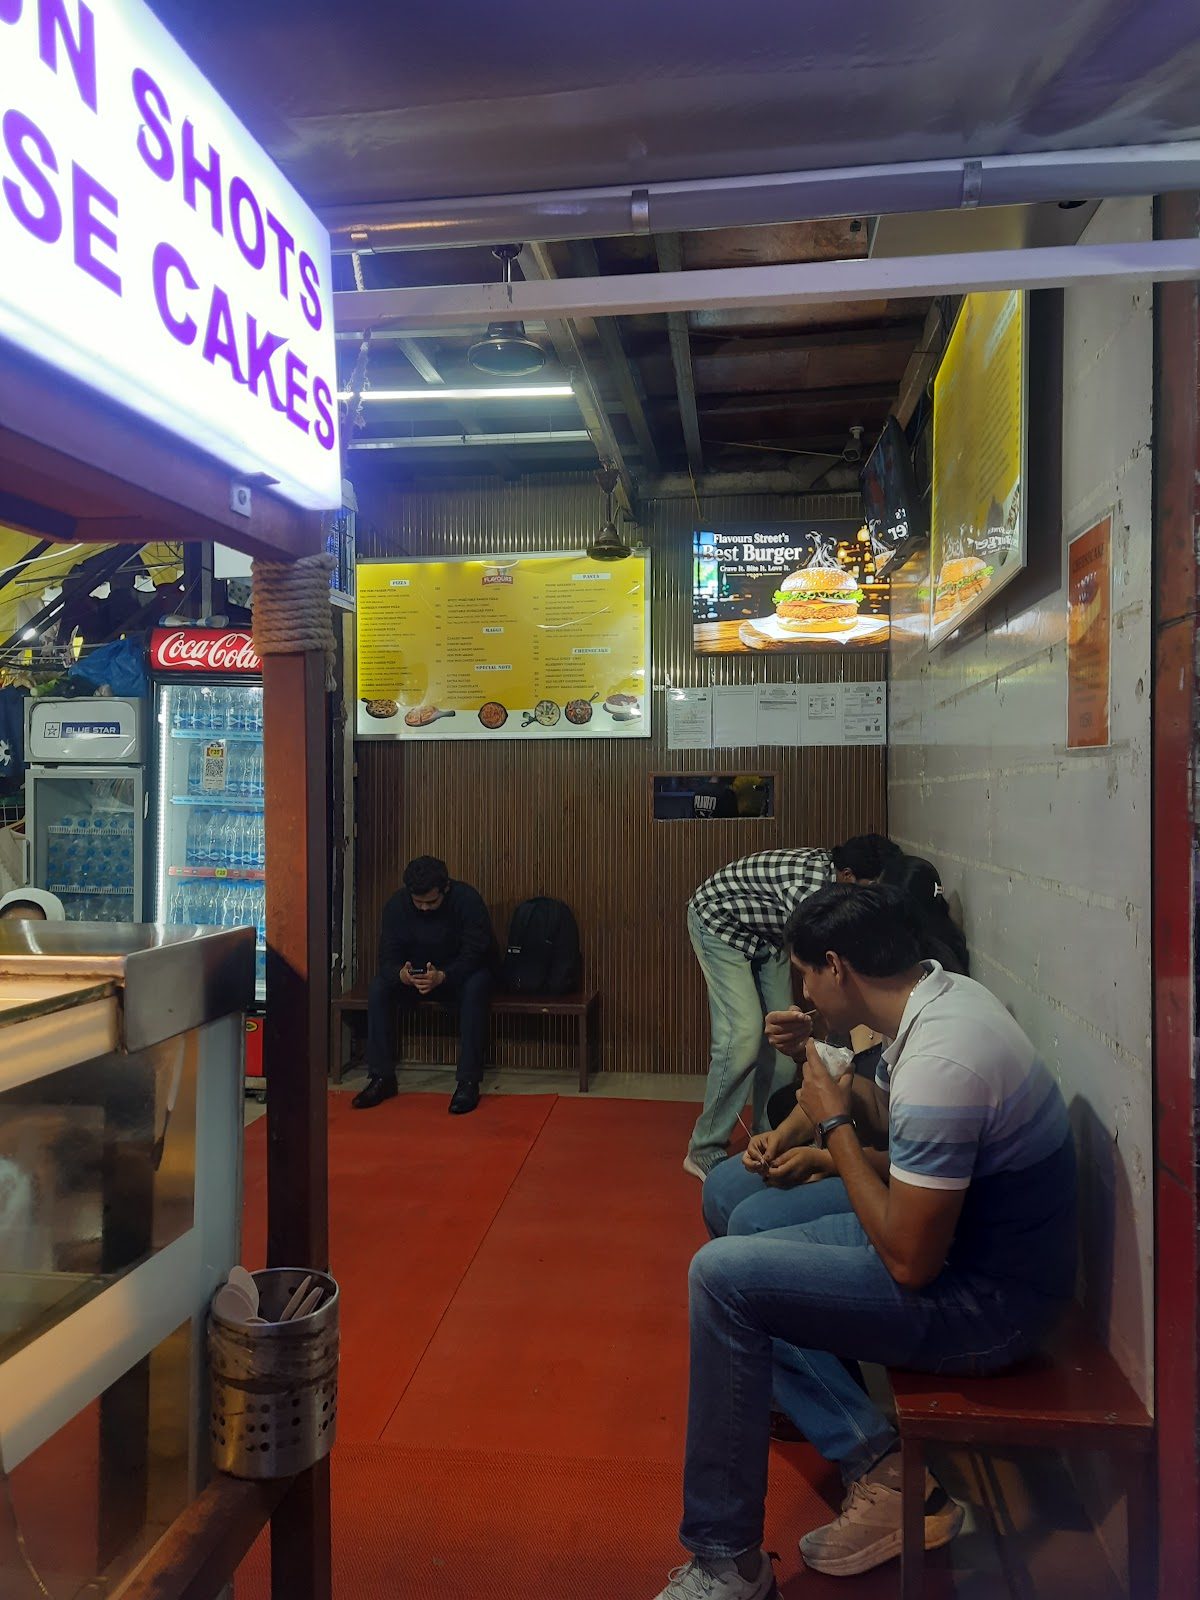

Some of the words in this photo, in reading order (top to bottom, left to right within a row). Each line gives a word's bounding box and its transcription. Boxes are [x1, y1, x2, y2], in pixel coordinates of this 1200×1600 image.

[0, 0, 97, 115] N
[131, 67, 322, 331] SHOTS
[2, 109, 122, 297] SE
[152, 241, 335, 451] CAKES
[713, 533, 753, 544] Flavours
[753, 532, 790, 544] Street's
[702, 544, 740, 562] Best
[742, 544, 803, 565] Burger
[157, 631, 260, 669] Coca-Cola
[65, 726, 91, 734] BLUE
[92, 726, 116, 735] STAR
